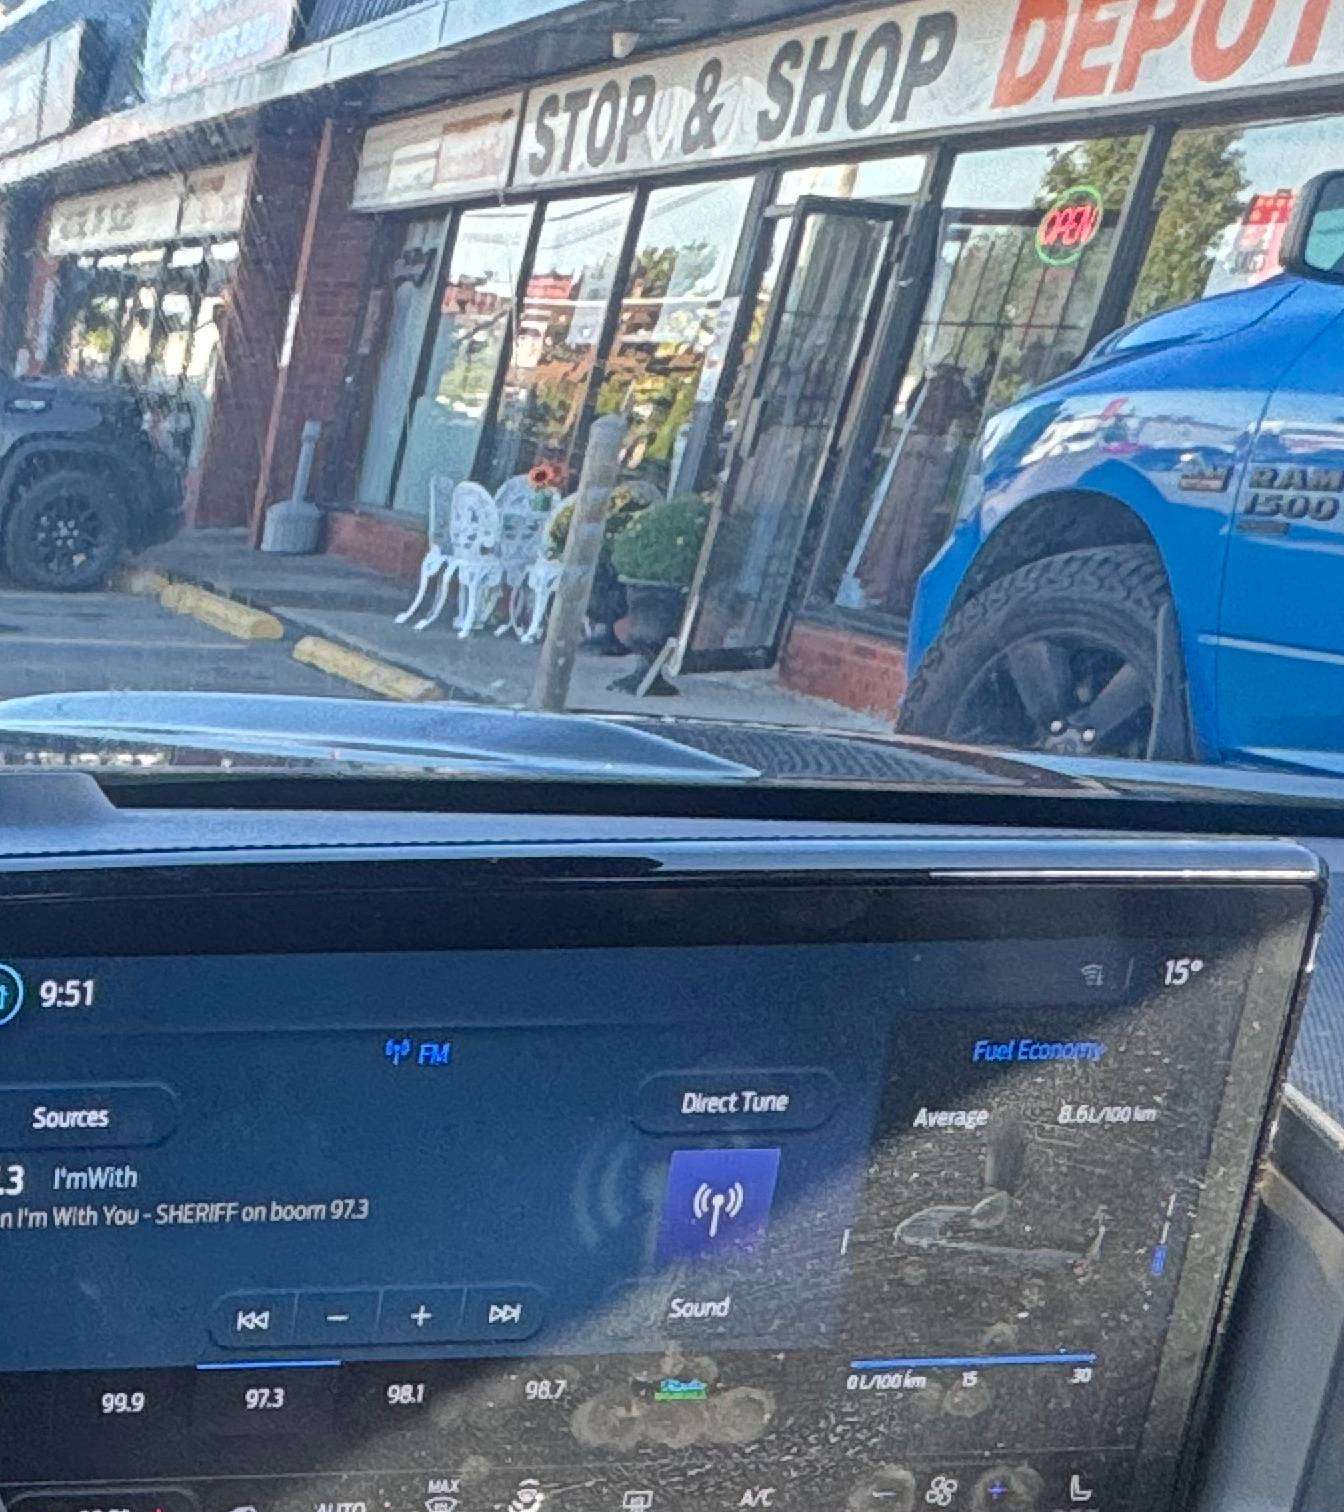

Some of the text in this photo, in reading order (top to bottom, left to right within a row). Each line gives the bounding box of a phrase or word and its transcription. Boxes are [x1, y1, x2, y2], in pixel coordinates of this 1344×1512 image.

[528, 74, 656, 177] STOP
[682, 57, 723, 154] &
[756, 11, 958, 142] SHOP
[1038, 204, 1100, 247] OPEN
[1250, 466, 1344, 493] RAM
[1244, 493, 1340, 522] 1500
[39, 978, 95, 1007] 9:51
[417, 1041, 451, 1066] FM
[973, 1039, 1107, 1062] Fuel Economy
[680, 1091, 789, 1114] Direct Tune
[32, 1106, 109, 1130] Sources
[913, 1107, 990, 1130] Average
[16, 1208, 47, 1229] I'm
[52, 1206, 97, 1228] With
[103, 1204, 139, 1227] You
[155, 1202, 240, 1225] SHERIFF
[242, 1205, 266, 1222] on
[270, 1201, 326, 1221] boom
[329, 1199, 369, 1220] 97.3
[669, 1297, 730, 1319] Sound
[245, 1388, 284, 1410] 97.3
[386, 1384, 424, 1405] 98.1
[524, 1380, 565, 1401] 98.7
[101, 1392, 145, 1414] 99.9
[428, 1480, 458, 1494] MAX
[739, 1488, 775, 1508] A/C
